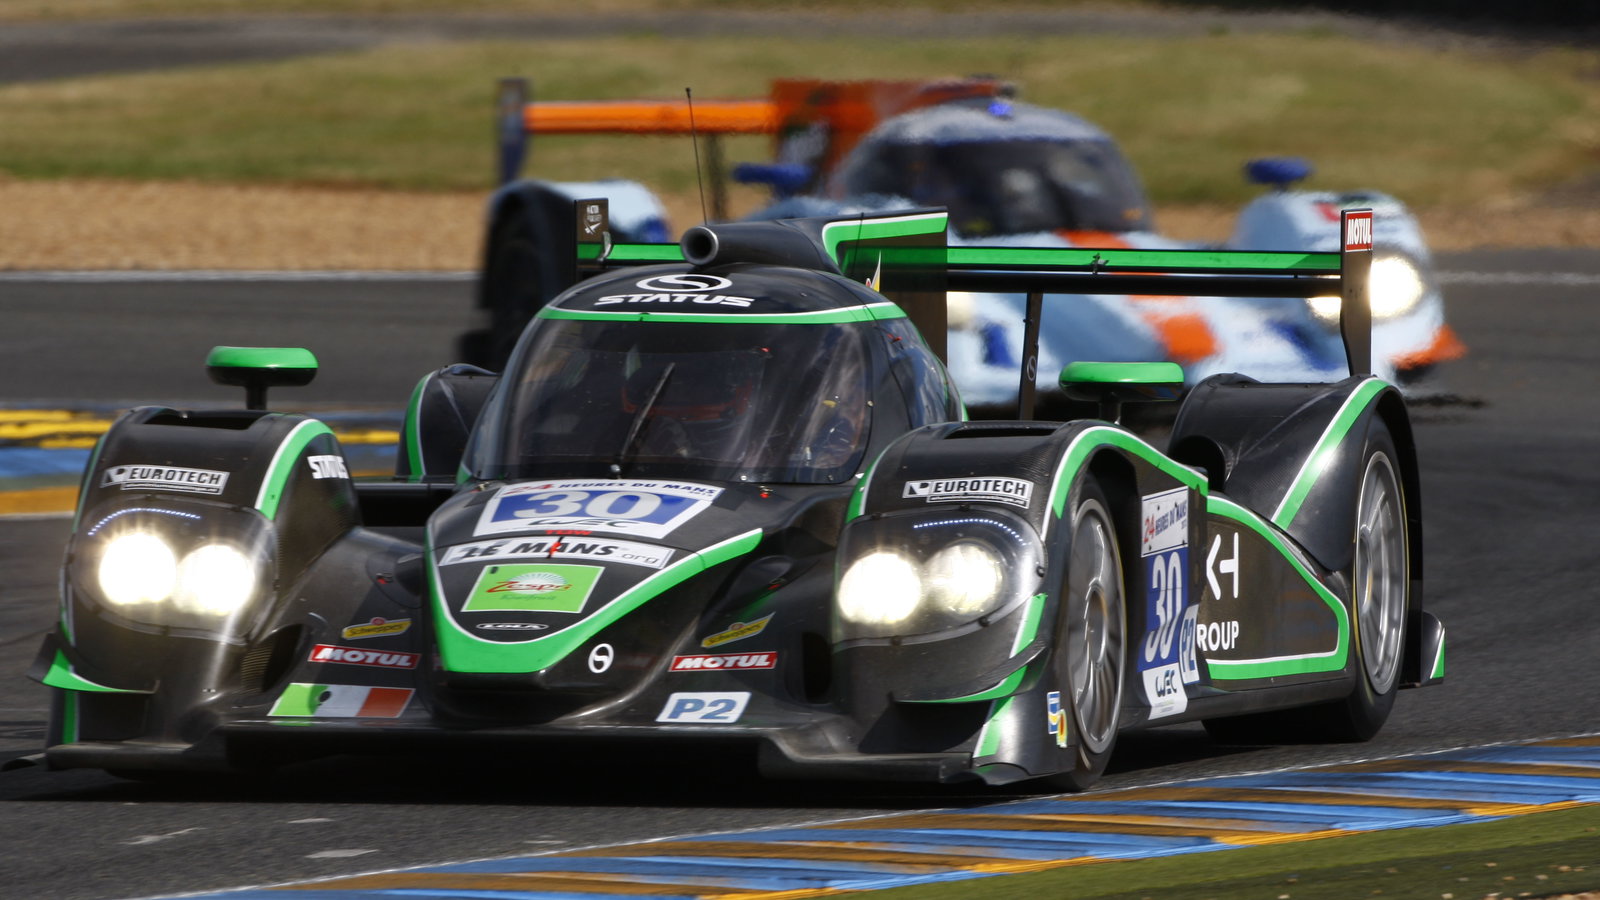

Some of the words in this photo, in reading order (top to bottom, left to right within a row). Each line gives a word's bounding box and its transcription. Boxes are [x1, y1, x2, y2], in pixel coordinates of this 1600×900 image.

[1347, 217, 1371, 245] MOTUL
[593, 292, 755, 307] STATUS
[129, 467, 221, 485] EUROTECH
[662, 484, 717, 494] MANS
[934, 480, 1026, 496] EUROTECH
[513, 491, 663, 520] 30
[1143, 514, 1155, 544] 24
[1144, 550, 1182, 663] 30
[1181, 618, 1196, 673] P2
[315, 647, 413, 667] MOTUL
[674, 654, 771, 669] MOTUL
[1155, 670, 1177, 697] WEC
[667, 698, 737, 720] P2
